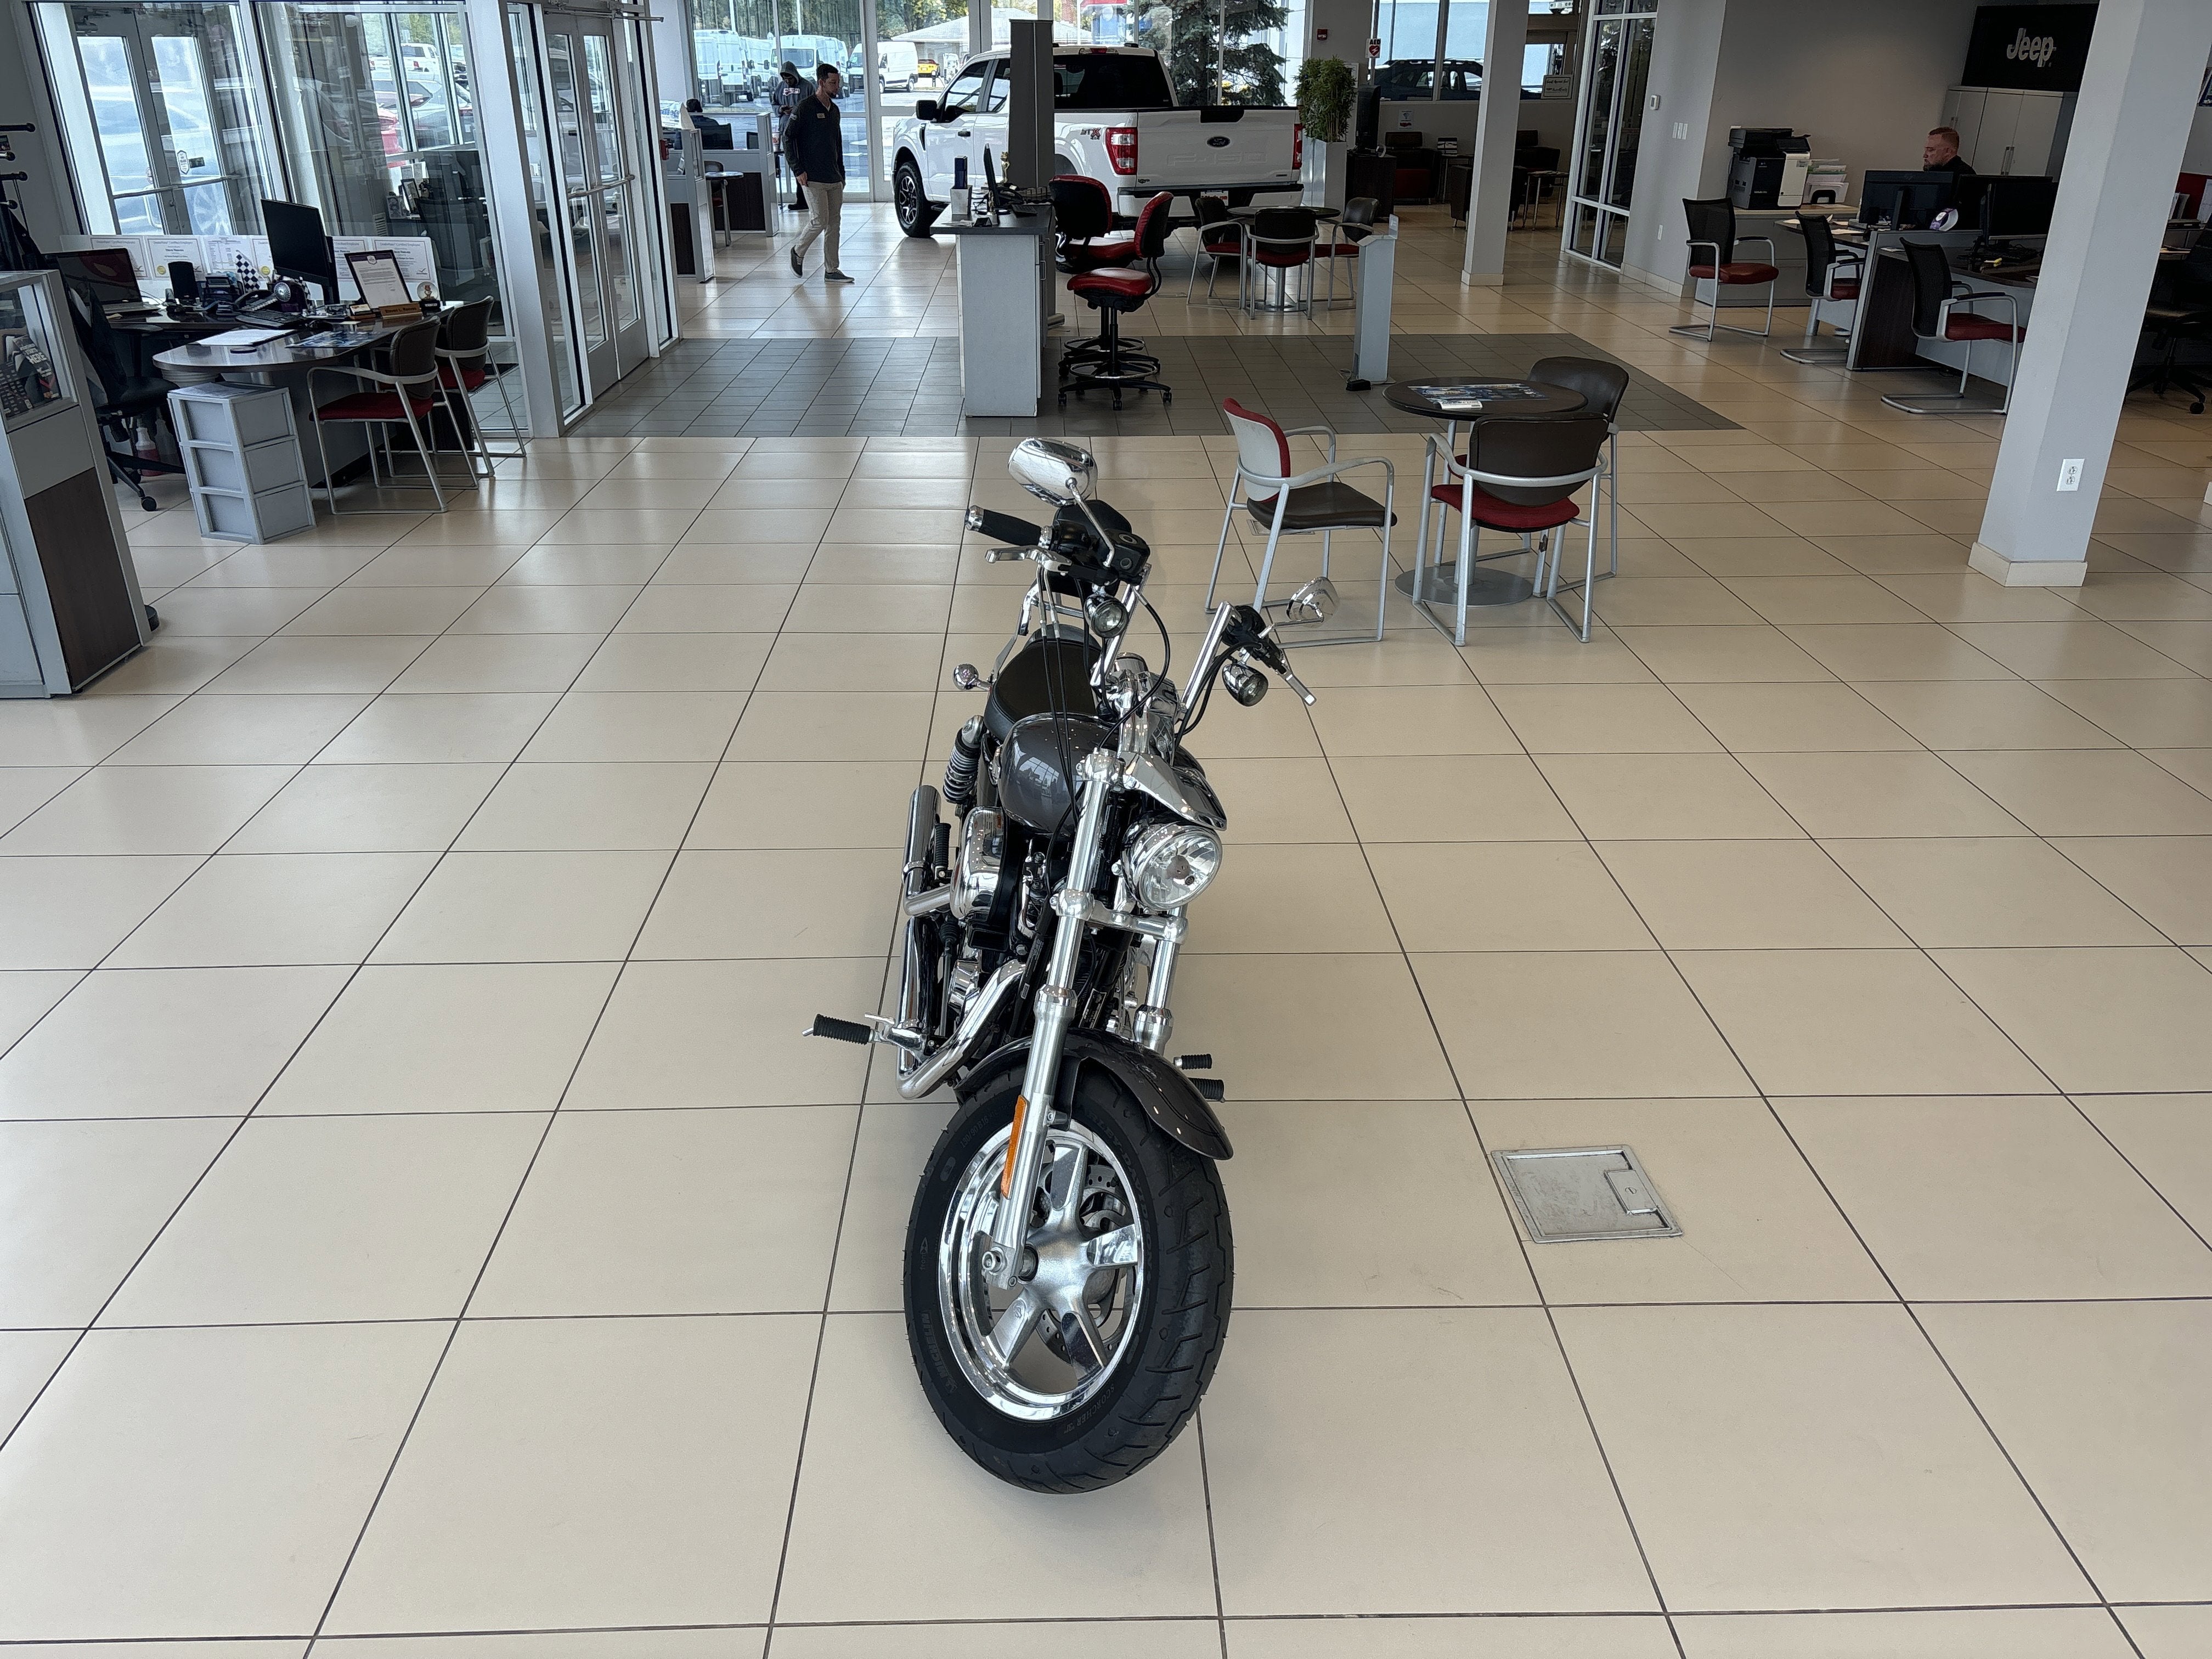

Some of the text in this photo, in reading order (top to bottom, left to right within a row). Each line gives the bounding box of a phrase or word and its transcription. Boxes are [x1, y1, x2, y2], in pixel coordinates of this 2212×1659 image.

[2006, 27, 2054, 67] Jeep
[1080, 127, 1102, 137] STX
[1166, 151, 1268, 167] F-150
[26, 352, 47, 364] HERE
[921, 1313, 949, 1379] MICHELIN
[1077, 1384, 1114, 1426] SCORCHER
